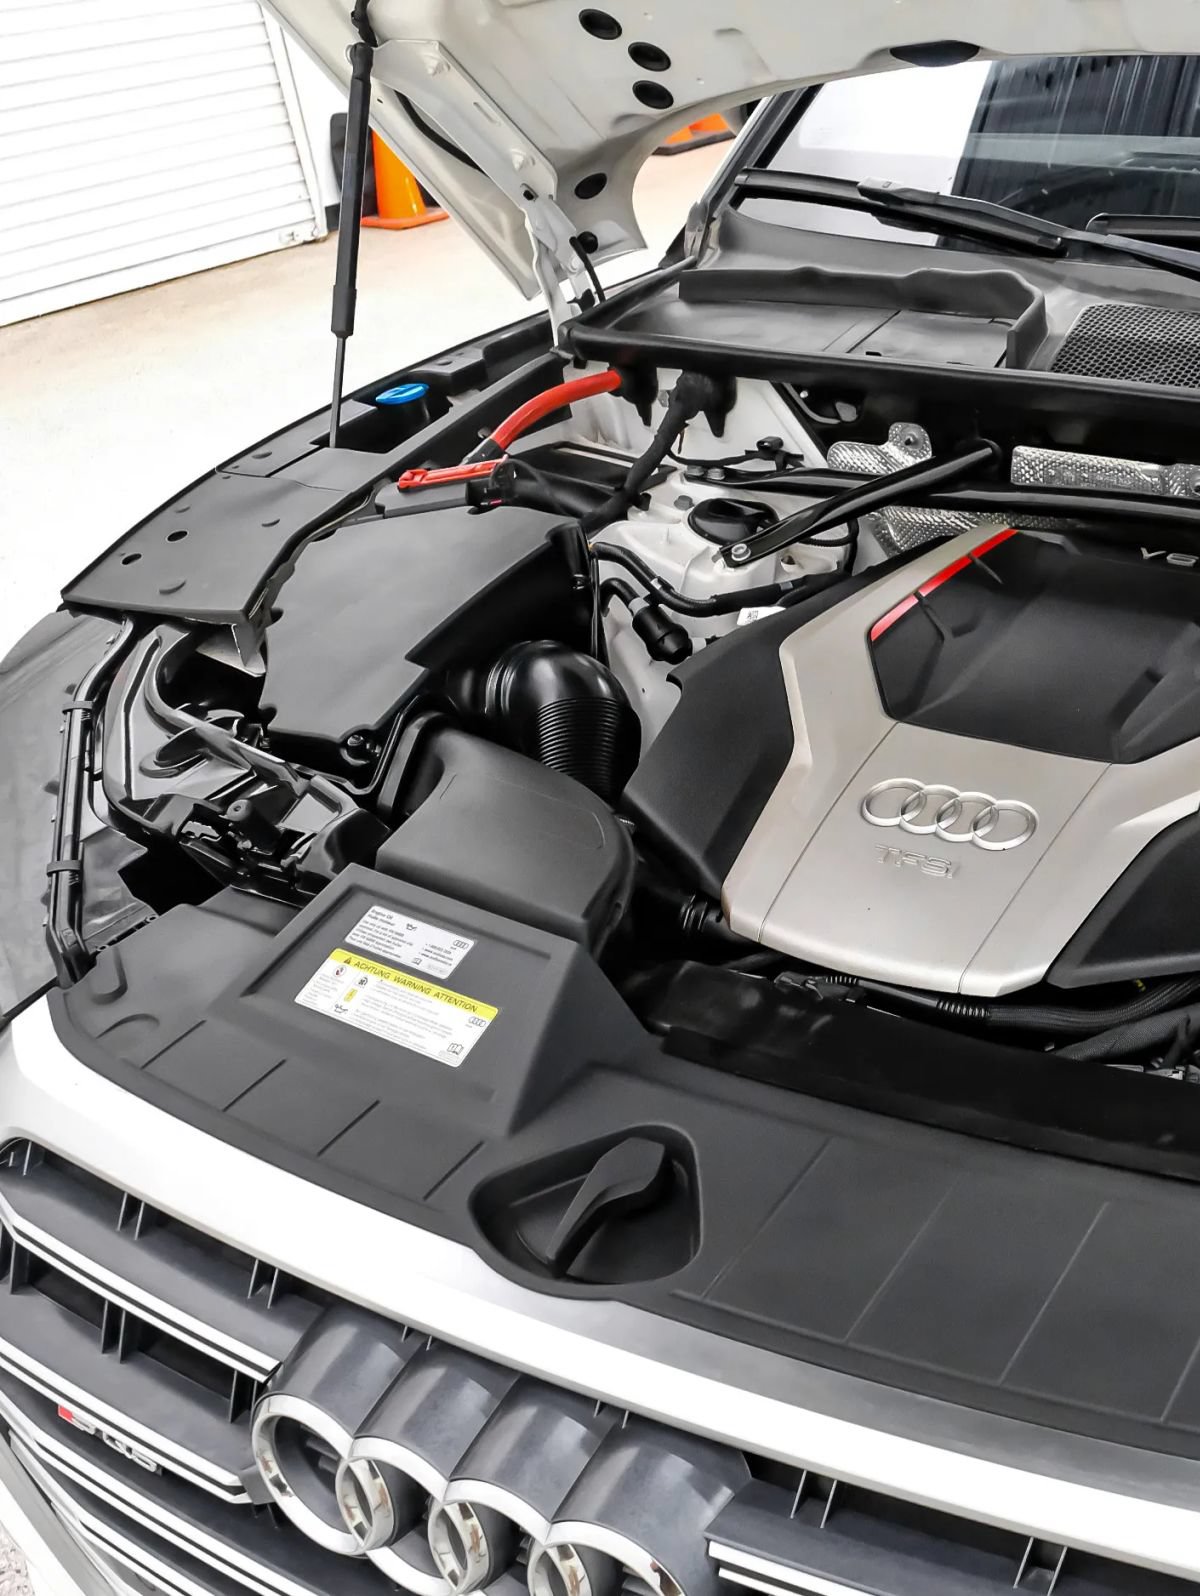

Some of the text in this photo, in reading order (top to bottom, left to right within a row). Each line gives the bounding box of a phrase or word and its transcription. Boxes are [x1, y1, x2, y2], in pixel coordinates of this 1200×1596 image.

[1140, 547, 1199, 567] V6
[354, 960, 390, 979] ACHTUNG
[393, 976, 432, 994] WARNING
[434, 991, 477, 1012] ATTENTION
